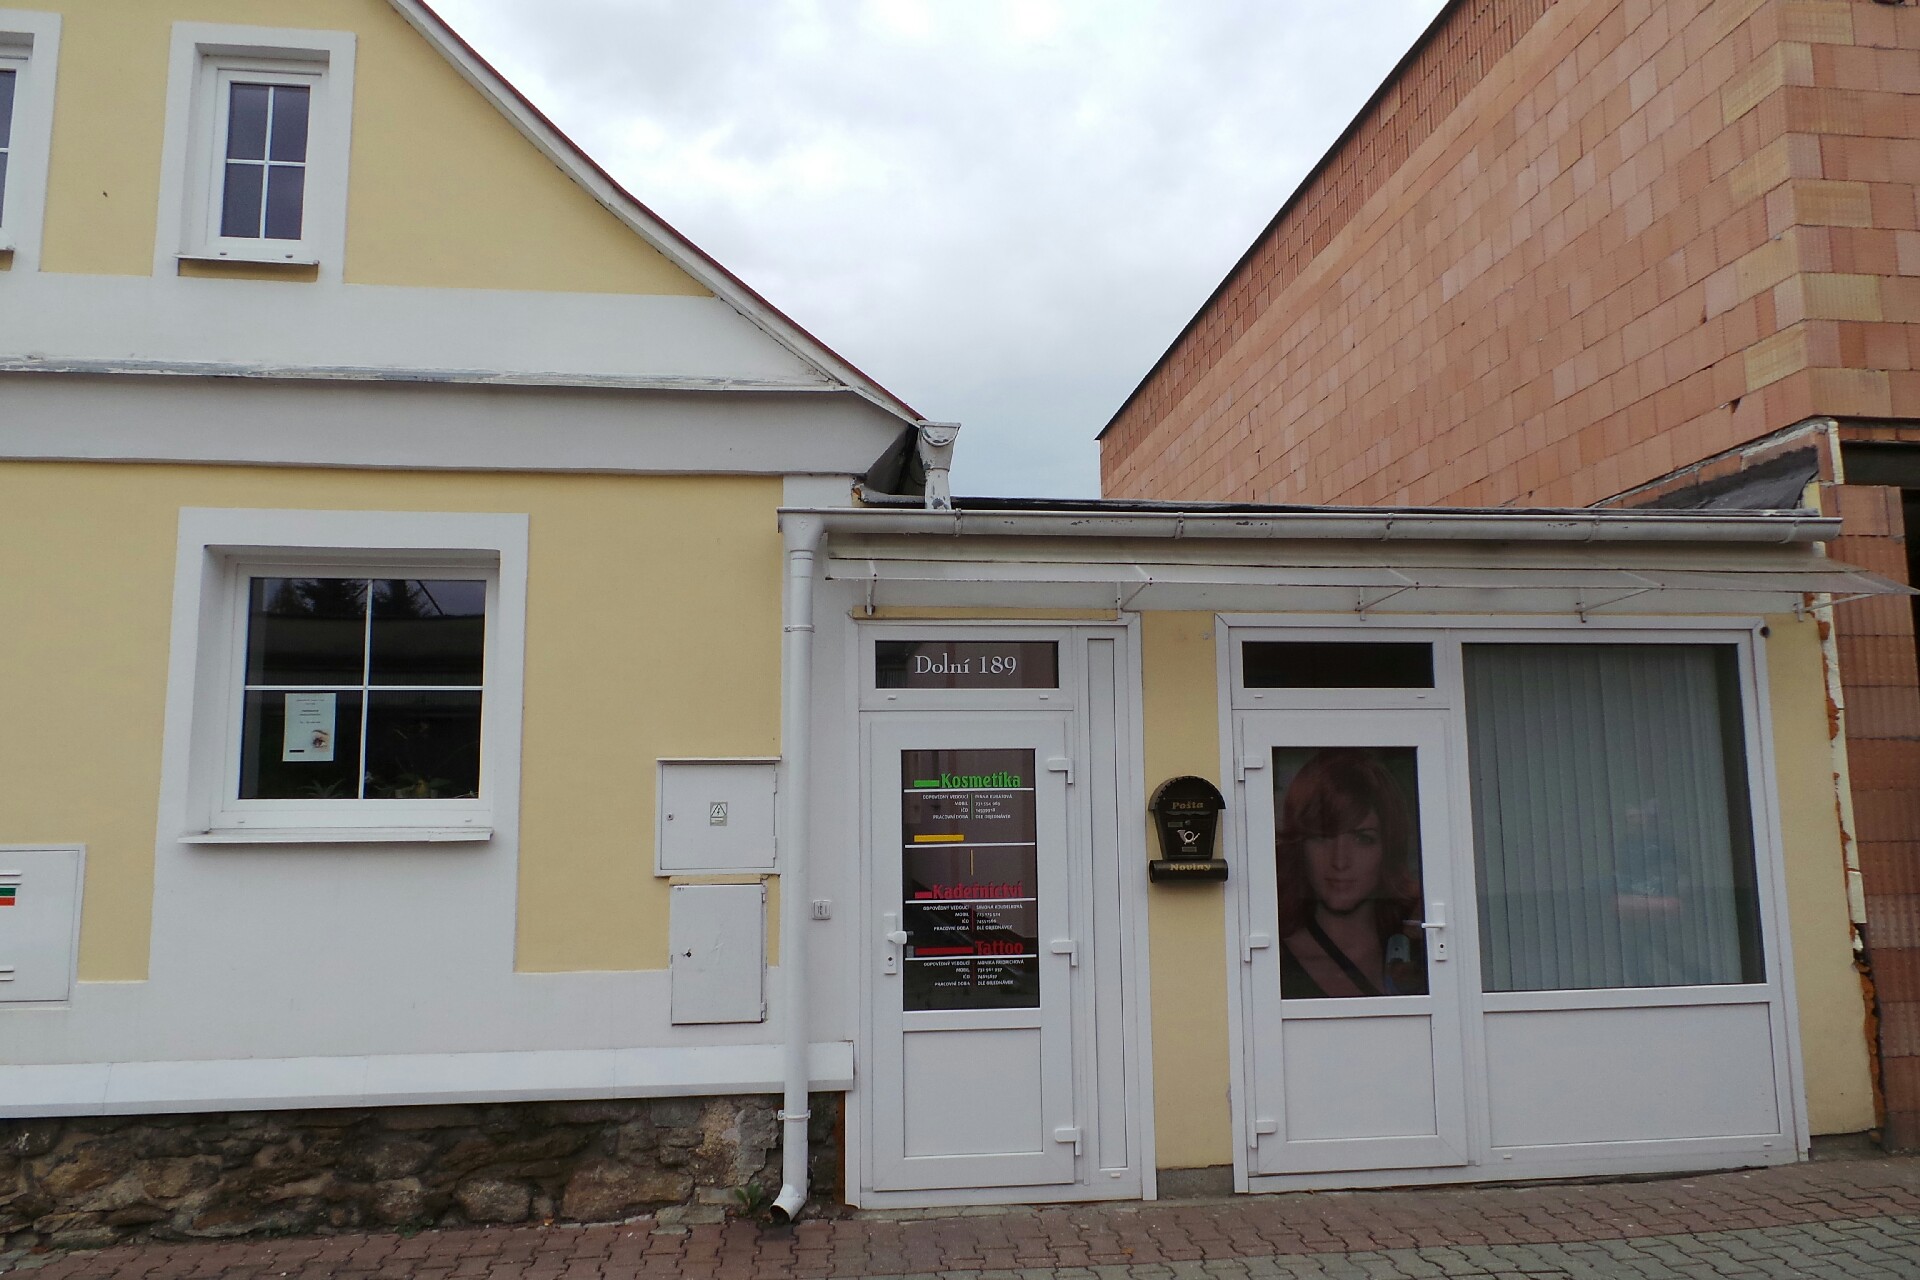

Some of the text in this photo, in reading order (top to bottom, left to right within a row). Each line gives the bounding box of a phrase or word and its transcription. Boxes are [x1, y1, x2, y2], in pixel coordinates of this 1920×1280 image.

[914, 653, 1016, 676] Dolní 189
[941, 771, 1020, 788] Kosmetika
[976, 940, 1024, 955] Tattoo
